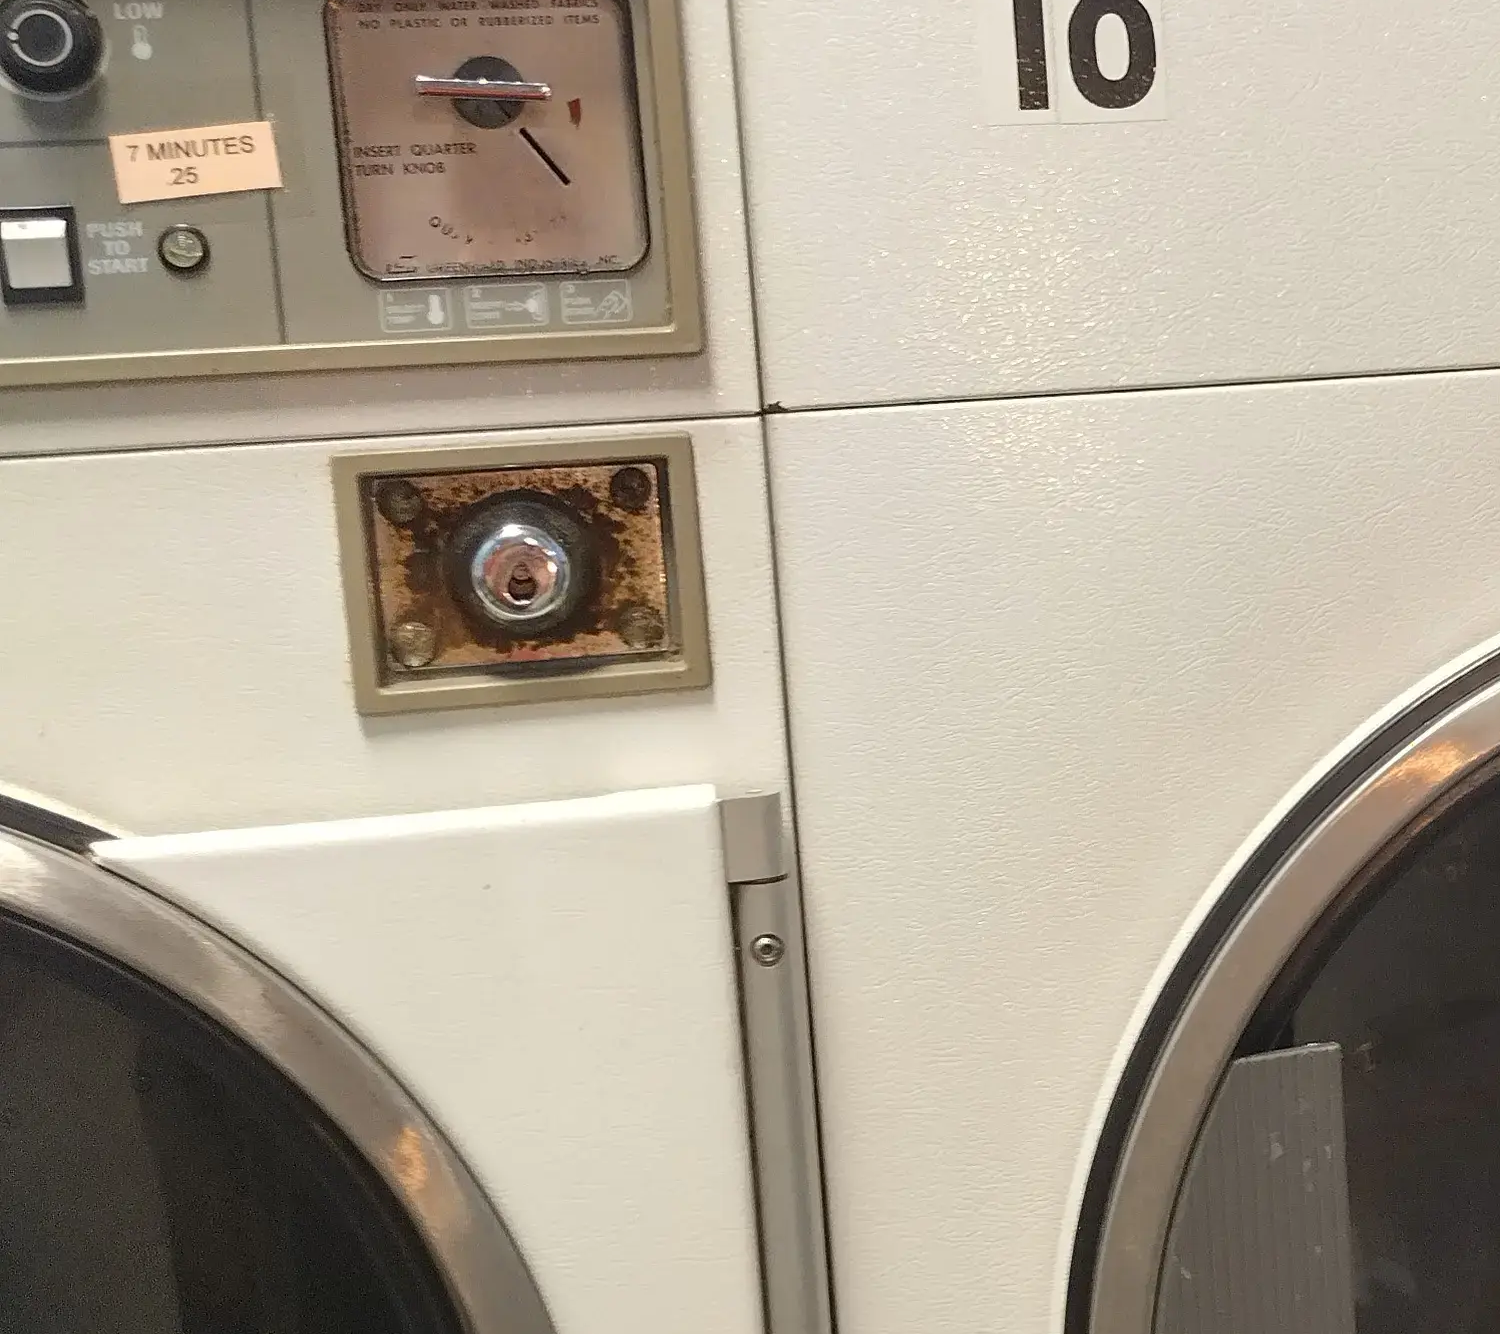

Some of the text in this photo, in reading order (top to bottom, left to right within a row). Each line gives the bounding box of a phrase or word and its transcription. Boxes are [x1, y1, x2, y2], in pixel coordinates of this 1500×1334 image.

[112, 2, 165, 20] LOW
[392, 1, 426, 13] ONLY
[438, 0, 478, 12] WATER
[358, 13, 601, 30] NO PLASTIC OR RUBBERIZED ITEMS
[125, 135, 256, 163] 7 MINUTES
[353, 142, 478, 158] INSERT QUARTER
[355, 162, 446, 177] TURN KNOB
[86, 220, 144, 238] PUSH
[102, 239, 131, 256] TO
[88, 257, 150, 275] START
